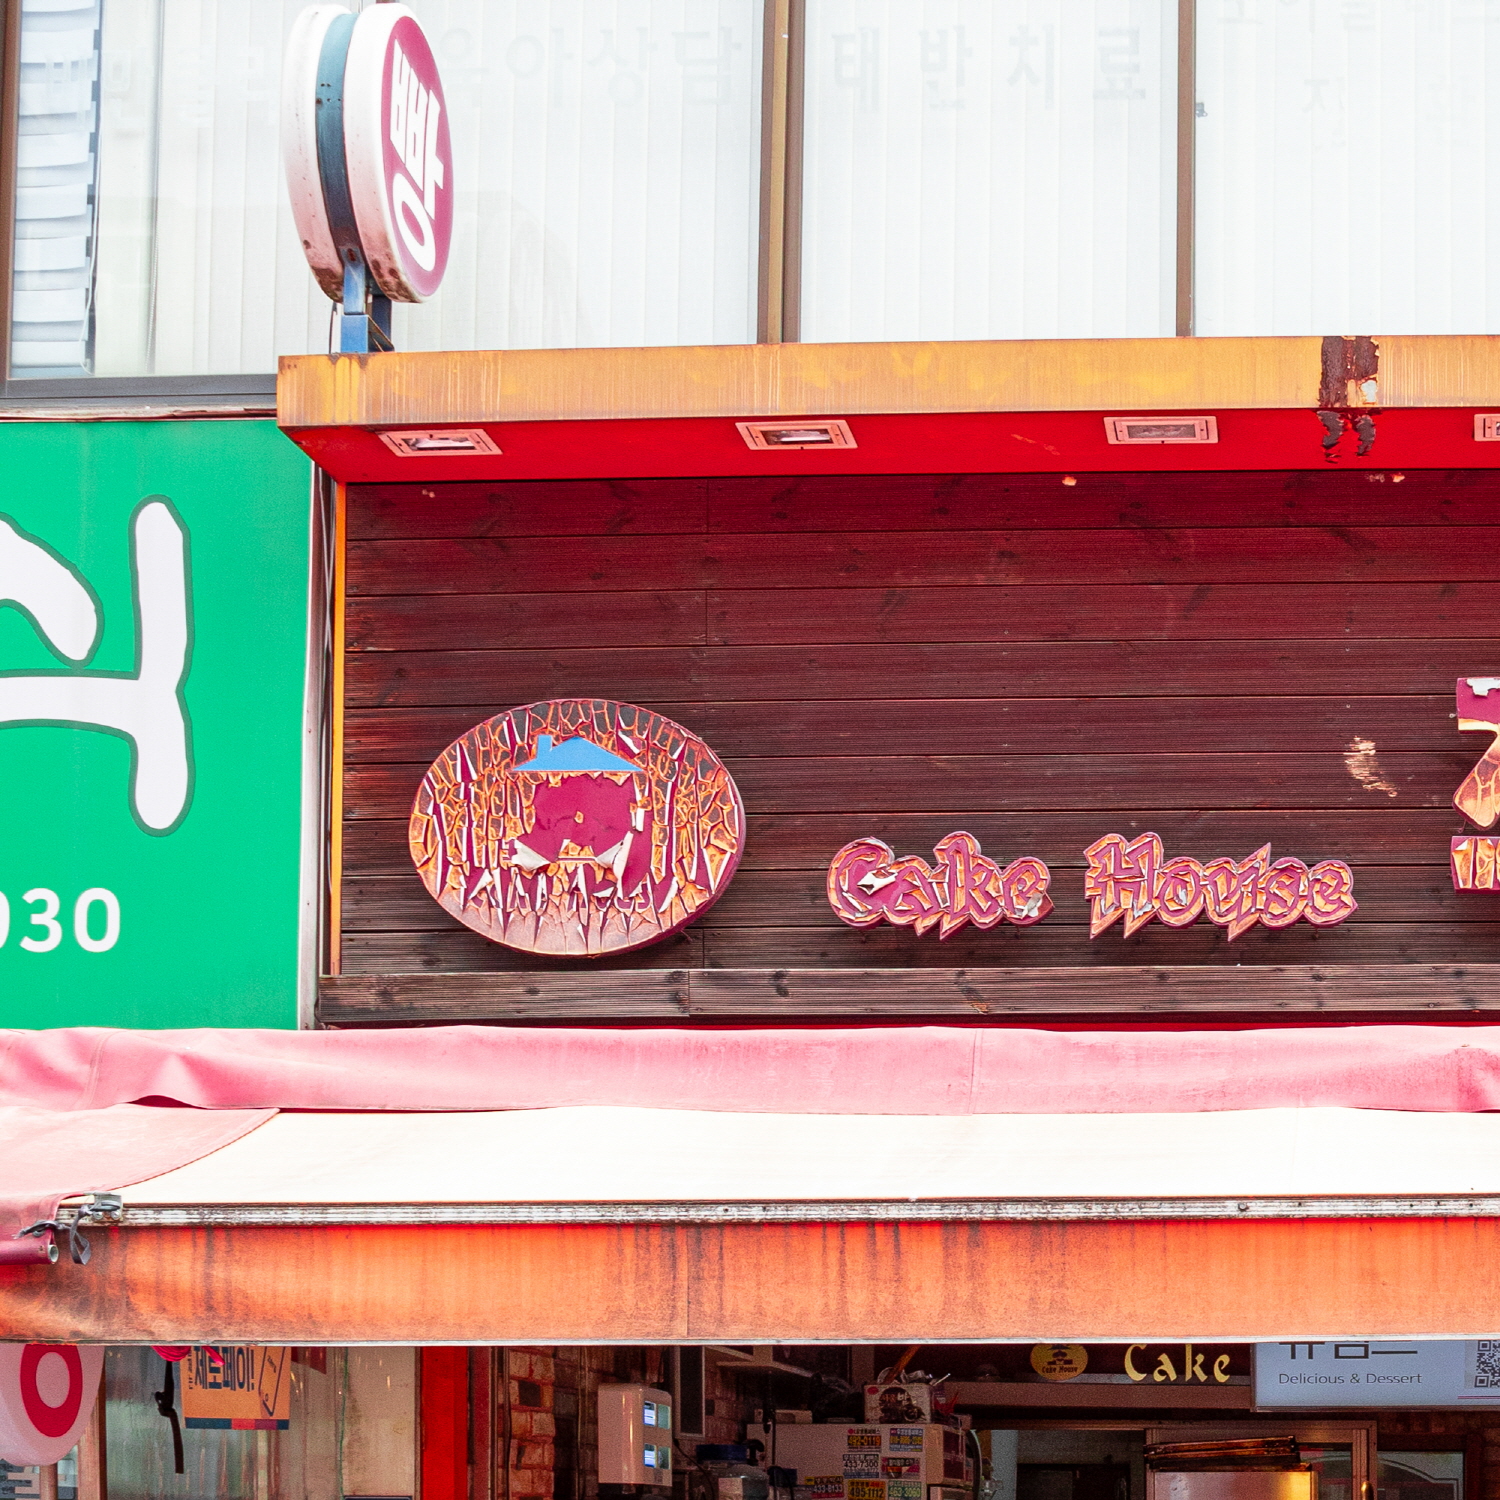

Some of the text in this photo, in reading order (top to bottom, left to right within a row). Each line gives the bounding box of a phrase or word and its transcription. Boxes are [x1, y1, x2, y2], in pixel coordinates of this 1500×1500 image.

[388, 38, 446, 272] 빵
[828, 830, 1358, 942] Cake House
[0, 887, 120, 953] 30
[1124, 1343, 1232, 1384] Cake
[1279, 1373, 1423, 1384] Delicious & Dessert
